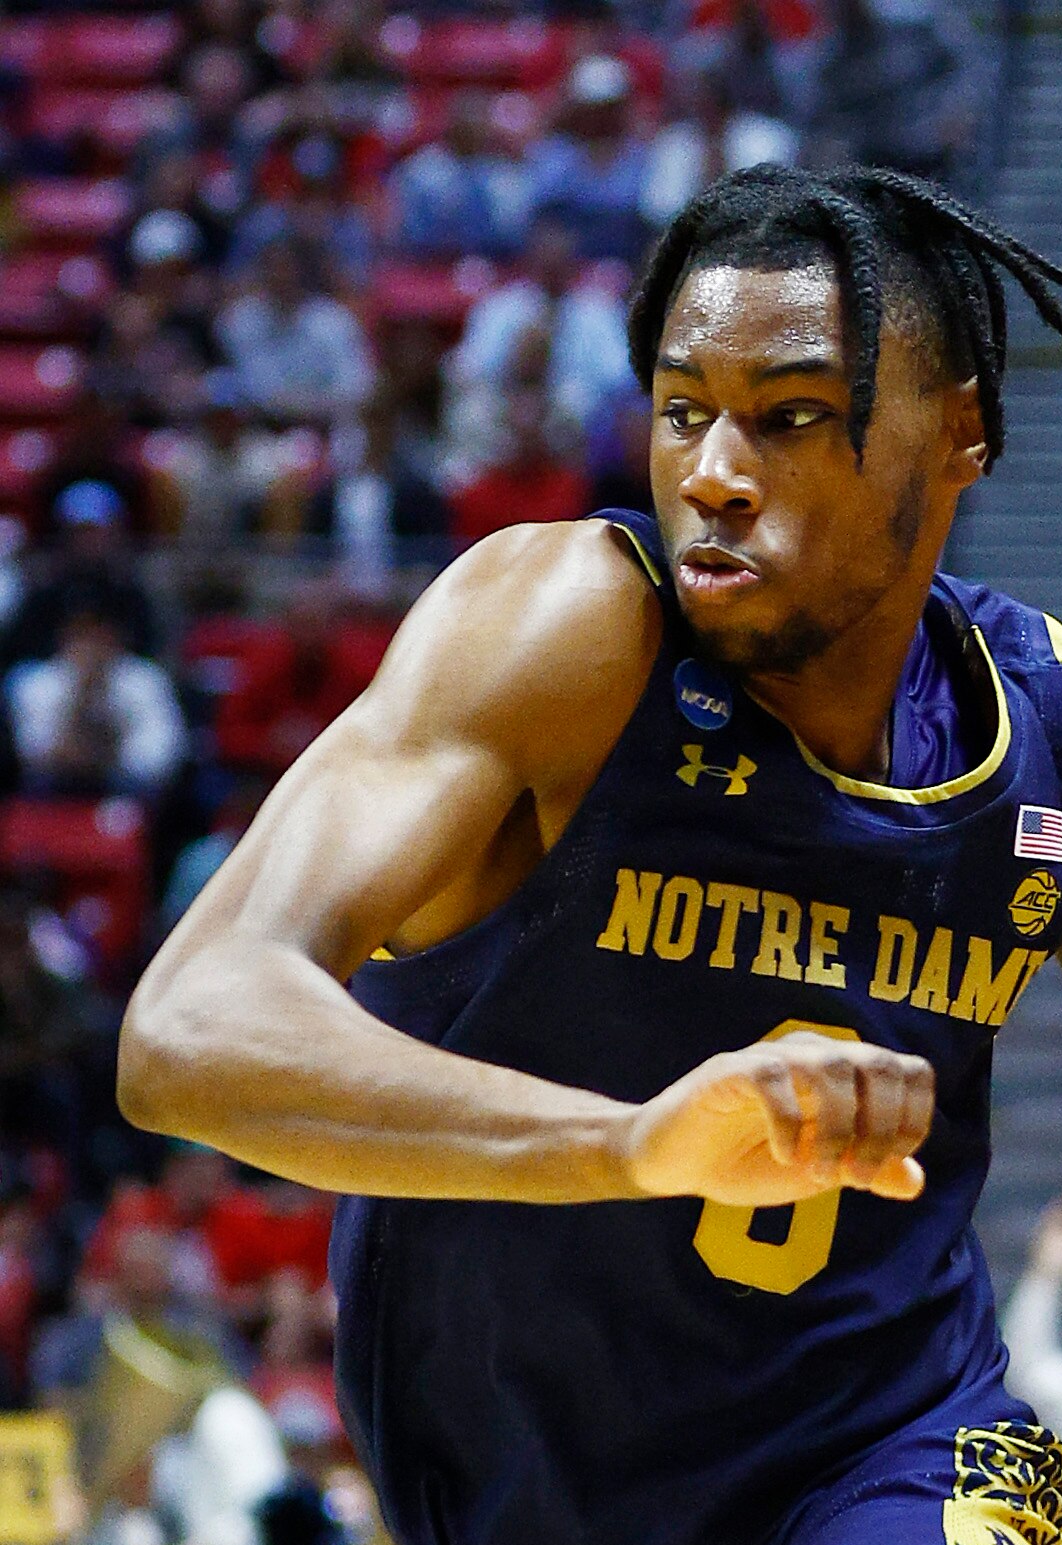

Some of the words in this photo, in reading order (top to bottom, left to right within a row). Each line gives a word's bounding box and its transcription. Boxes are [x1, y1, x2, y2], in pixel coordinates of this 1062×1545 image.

[1015, 890, 1059, 909] ACC
[596, 868, 850, 989] NOTRE
[868, 914, 1049, 1026] DAM
